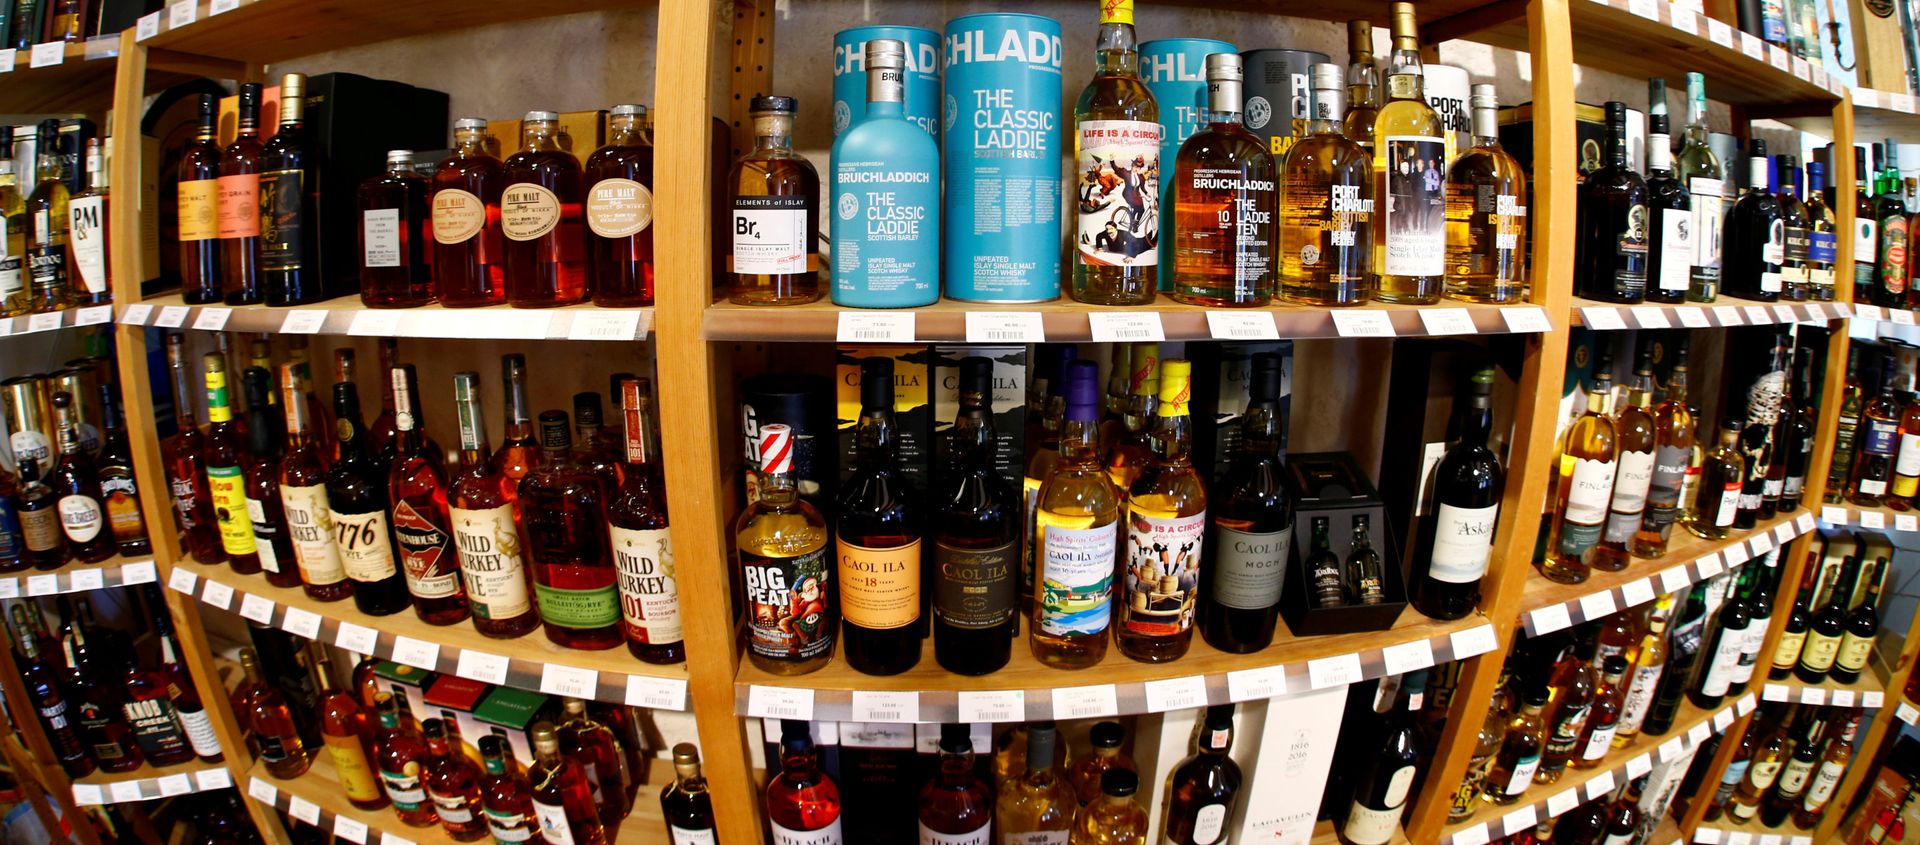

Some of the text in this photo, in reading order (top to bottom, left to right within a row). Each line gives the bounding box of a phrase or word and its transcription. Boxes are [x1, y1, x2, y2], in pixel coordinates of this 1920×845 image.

[973, 89, 1014, 109] THE
[1431, 96, 1463, 114] PORT
[974, 109, 1054, 131] CLASSIC
[975, 129, 1046, 150] LADDIE
[1083, 129, 1104, 138] LIFE
[1107, 129, 1119, 138] IS
[1121, 129, 1130, 138] A
[838, 172, 929, 184] BRUICHLADDICH
[1193, 178, 1274, 191] BRUICHLADDICH
[507, 192, 540, 203] PURE MALT
[597, 188, 635, 199] PURE MALT
[1331, 184, 1360, 199] PORT
[866, 192, 896, 206] THE
[1234, 198, 1256, 211] THE
[867, 206, 925, 221] CLASSIC
[1217, 210, 1230, 222] 10
[1236, 210, 1271, 224] LADDIE
[1332, 211, 1369, 222] SCOTTISH
[867, 220, 919, 235] LADDIE
[1236, 223, 1258, 235] TEN
[974, 255, 1009, 263] UNPEATED
[1018, 262, 1037, 270] MALT
[630, 447, 641, 458] 101
[1155, 525, 1165, 533] IS
[457, 529, 491, 553] WILD
[1234, 540, 1272, 555] CAOL
[616, 549, 654, 575] WILD
[842, 554, 905, 573] CAOL ILA
[1245, 559, 1281, 569] MOCH
[745, 565, 786, 590] BIG
[942, 562, 1008, 580] CAOL ILA
[864, 577, 877, 588] 18
[646, 597, 677, 606] KENTUCKY
[747, 585, 790, 607] PEAT
[1252, 811, 1312, 829] LAGAVULIN
